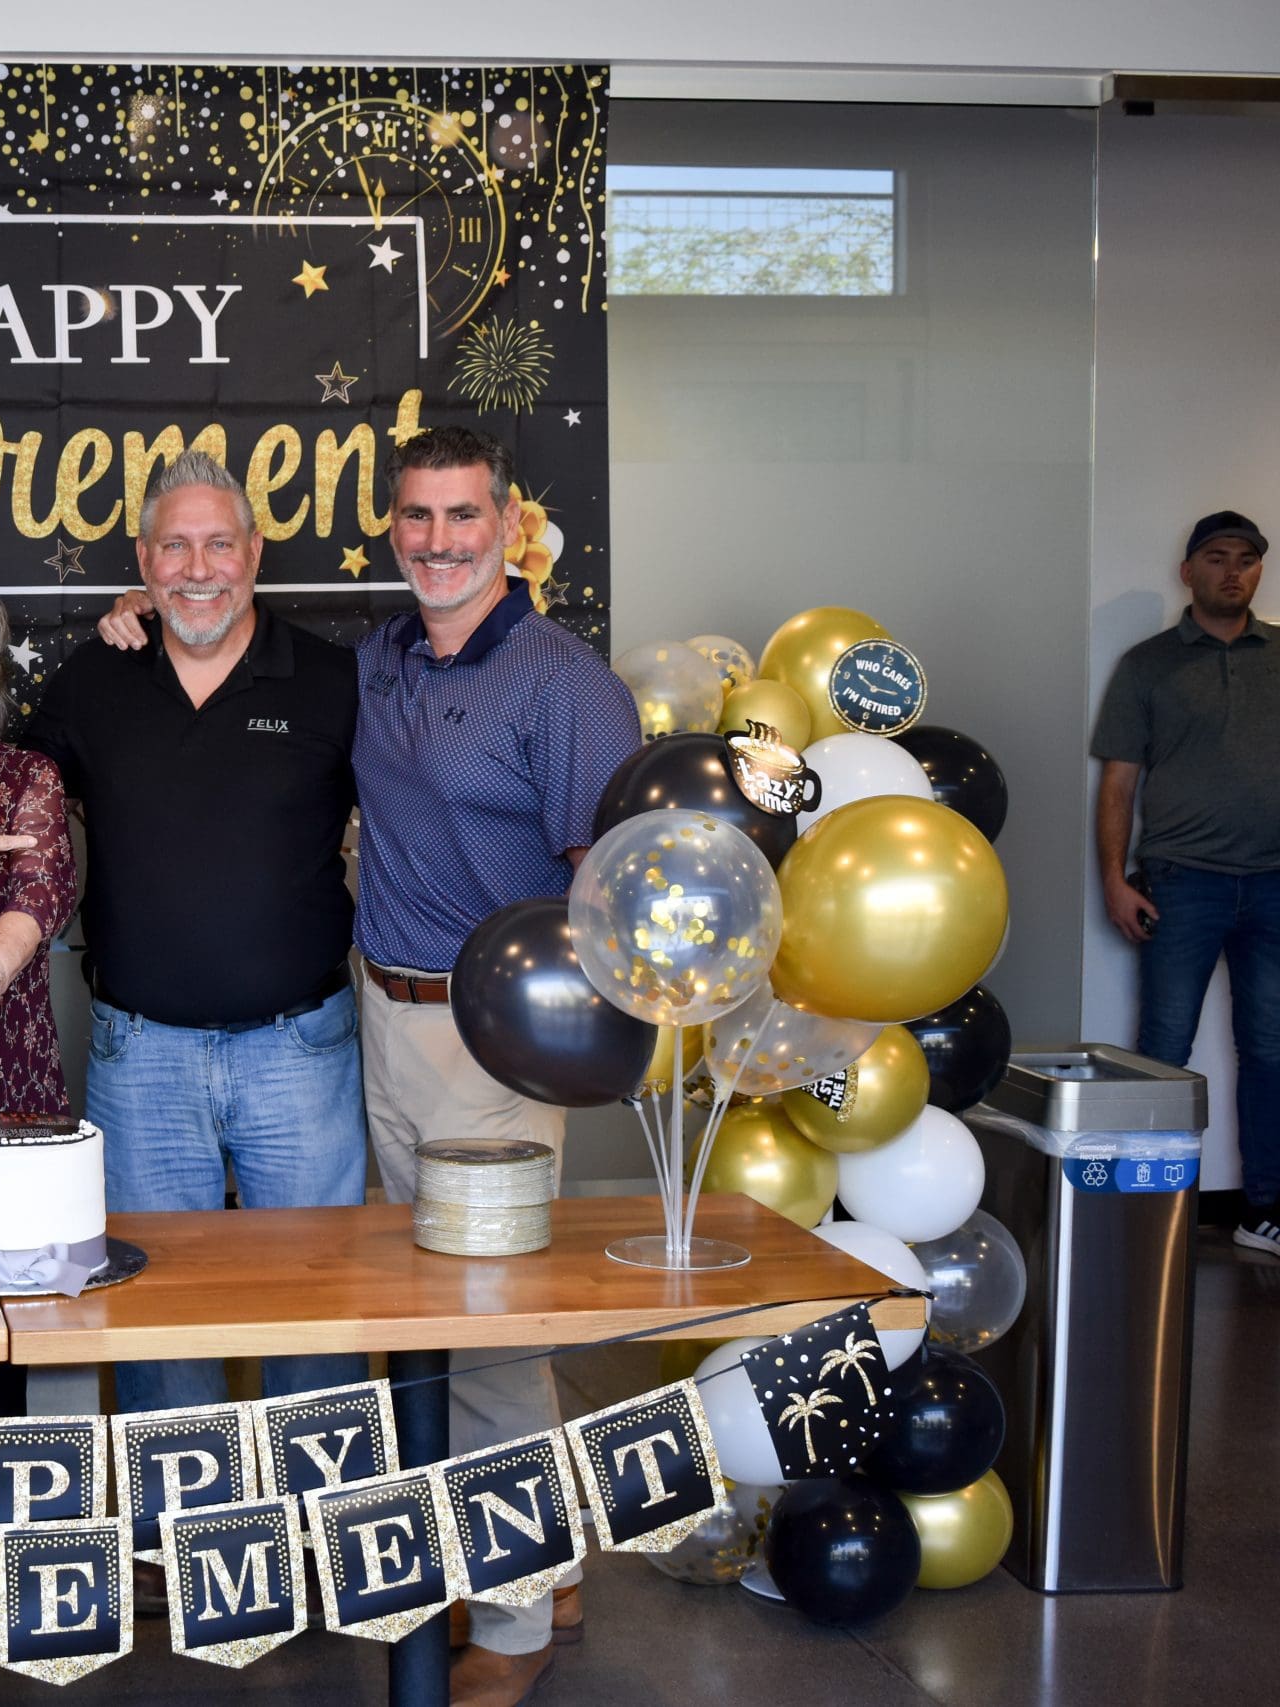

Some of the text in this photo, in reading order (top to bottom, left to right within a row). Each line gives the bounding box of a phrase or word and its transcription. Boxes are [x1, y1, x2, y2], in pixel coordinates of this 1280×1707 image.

[882, 655, 894, 666] 12
[843, 671, 851, 680] 9
[856, 659, 913, 690] WHO CARES
[842, 686, 902, 716] I'M RETIRED
[904, 696, 911, 705] 3
[247, 718, 289, 733] FELIX
[862, 711, 870, 720] 6
[738, 757, 797, 800] Lazy
[744, 782, 793, 813] time
[828, 1082, 845, 1107] THE
